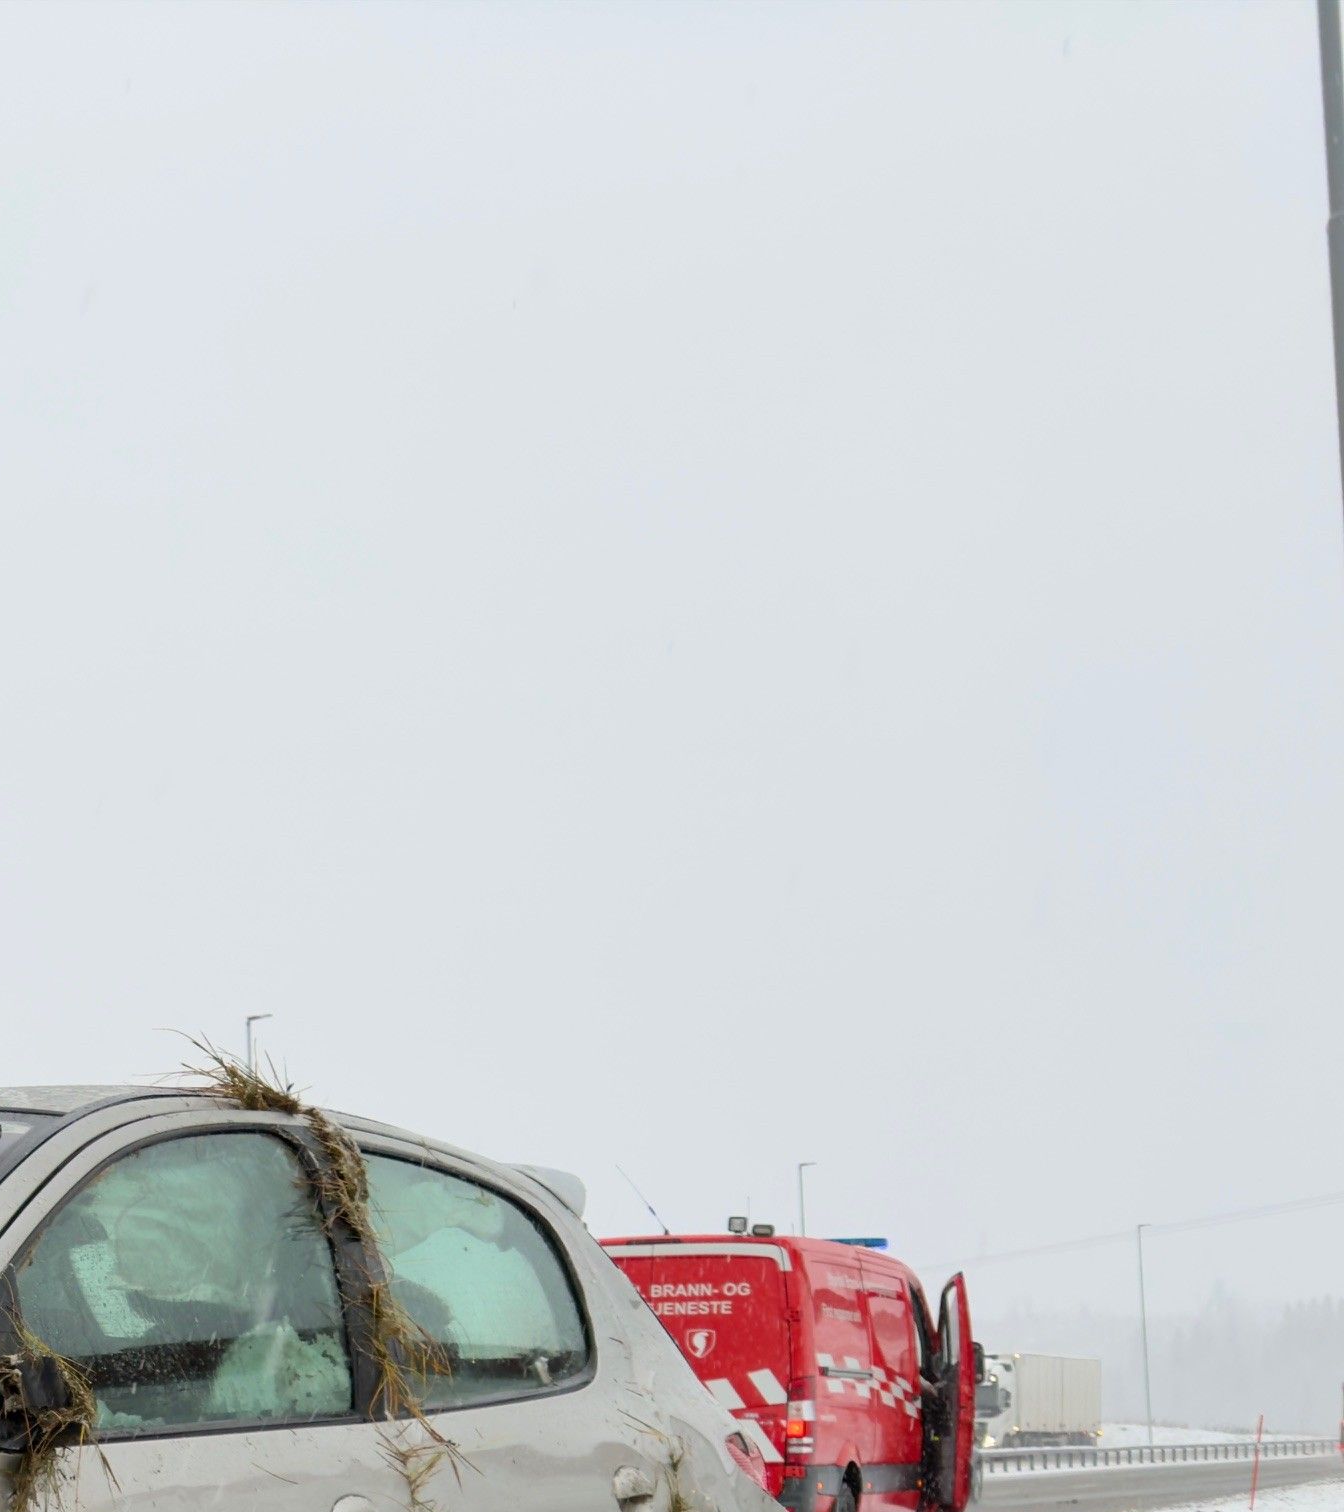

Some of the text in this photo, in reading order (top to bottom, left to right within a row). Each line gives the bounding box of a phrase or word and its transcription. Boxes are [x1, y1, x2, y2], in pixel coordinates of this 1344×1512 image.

[650, 1283, 719, 1298] BRANN-
[722, 1282, 751, 1296] OG
[646, 1300, 732, 1316] JENESTE
